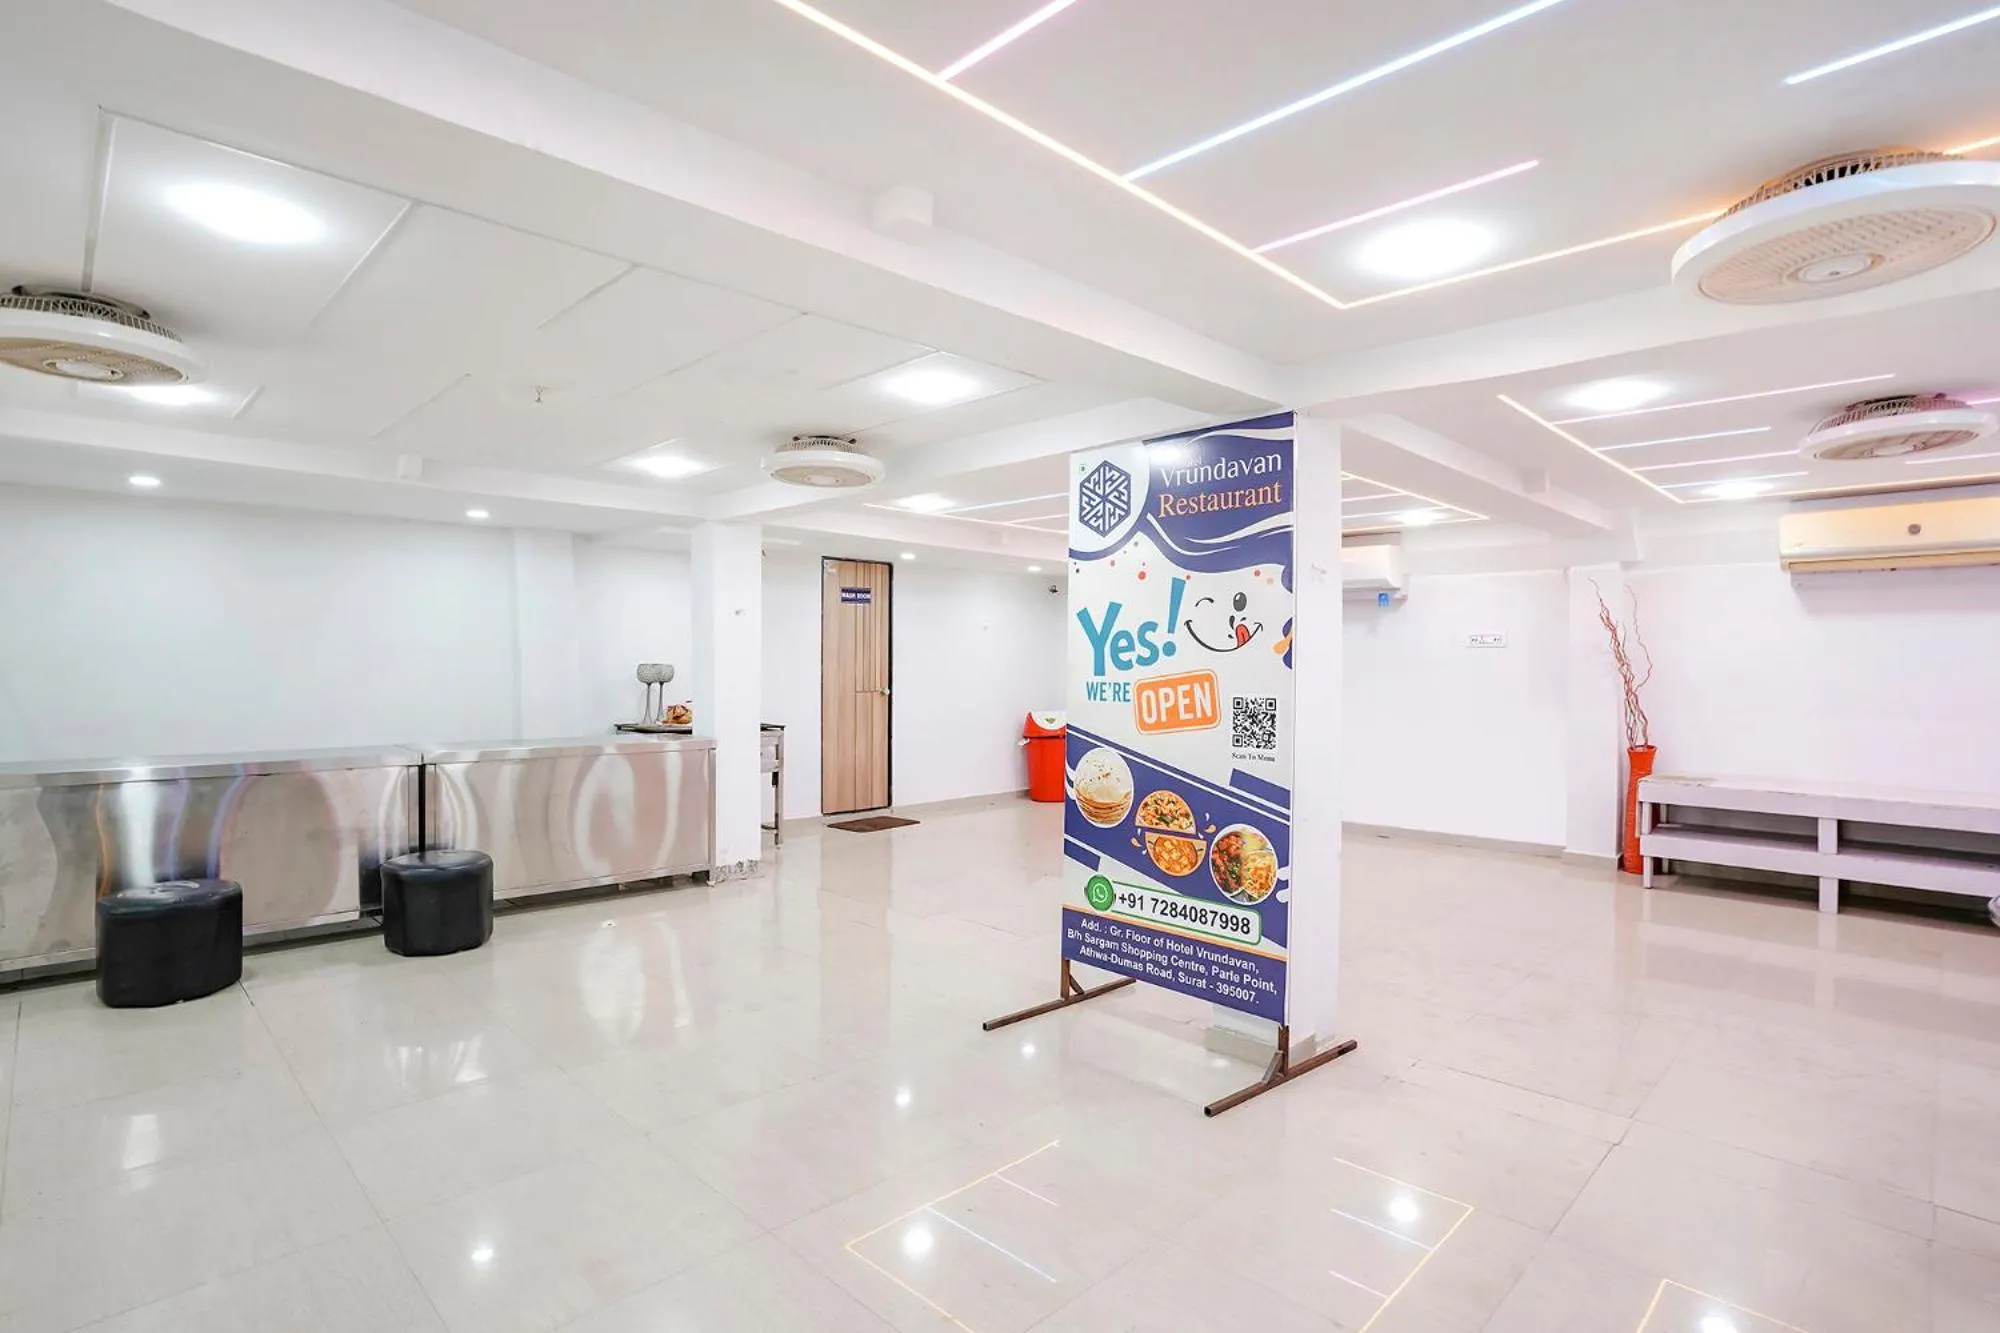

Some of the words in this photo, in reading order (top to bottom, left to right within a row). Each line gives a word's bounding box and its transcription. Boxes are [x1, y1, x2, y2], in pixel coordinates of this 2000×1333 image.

[1160, 453, 1282, 488] Vrundavan
[1158, 481, 1282, 519] Restaurant
[1076, 577, 1186, 677] Yes!
[1086, 680, 1131, 702] WE'RE
[1141, 681, 1213, 725] OPEN
[1118, 892, 1145, 911] +91
[1151, 898, 1251, 935] 7284087998
[1084, 933, 1120, 951] Sargam
[1121, 942, 1168, 966] Shopping
[1171, 954, 1209, 976] Centre,
[1243, 974, 1278, 995] Point,
[1110, 925, 1124, 938] Gr.
[1126, 929, 1151, 945] Floor
[1154, 937, 1164, 948] of
[1166, 940, 1194, 956] Hotel
[1196, 947, 1260, 974] Vrundavan,
[1079, 945, 1144, 971] Athwa-Dumas
[1146, 964, 1175, 981] Road,
[1178, 974, 1207, 989] Surat
[1215, 981, 1260, 1004] 395007.
